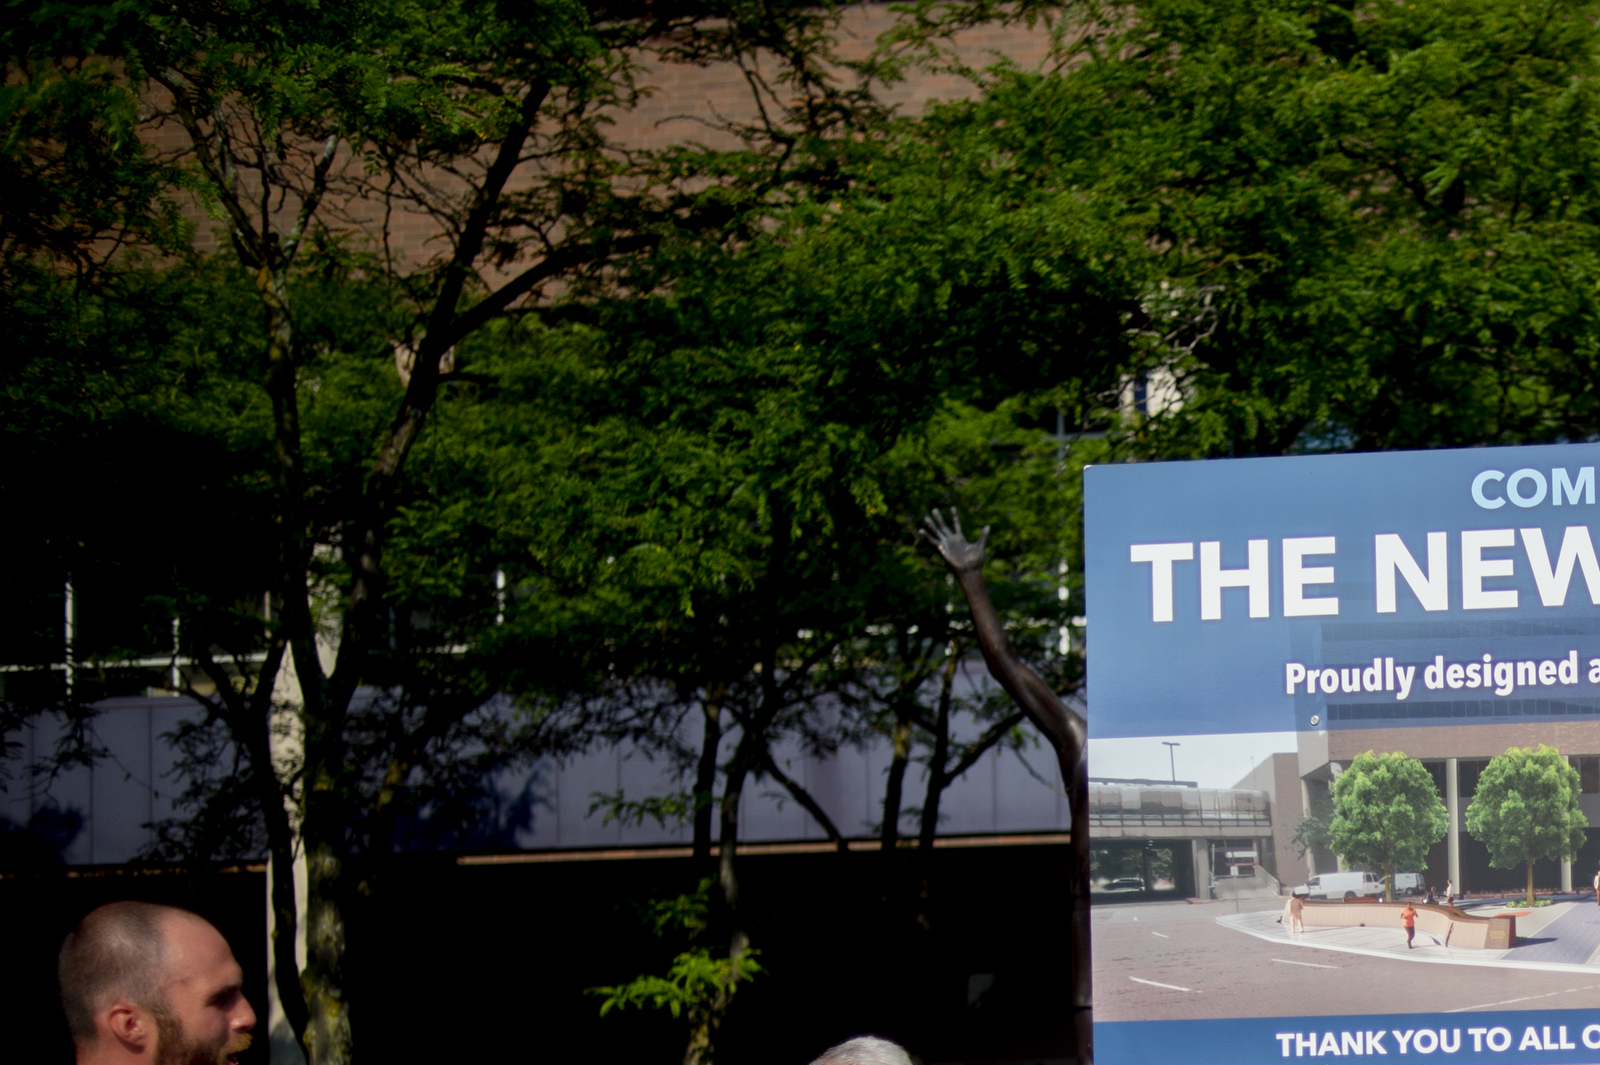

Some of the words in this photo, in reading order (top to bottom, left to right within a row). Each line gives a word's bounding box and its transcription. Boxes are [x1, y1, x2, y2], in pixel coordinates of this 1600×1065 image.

[1131, 537, 1338, 622] THE
[1286, 658, 1415, 699] Proudly
[1425, 651, 1577, 696] designed
[1276, 1031, 1387, 1056] THANK
[1392, 1029, 1460, 1053] YOU
[1468, 1027, 1511, 1051] TO
[1519, 1026, 1575, 1050] ALL
